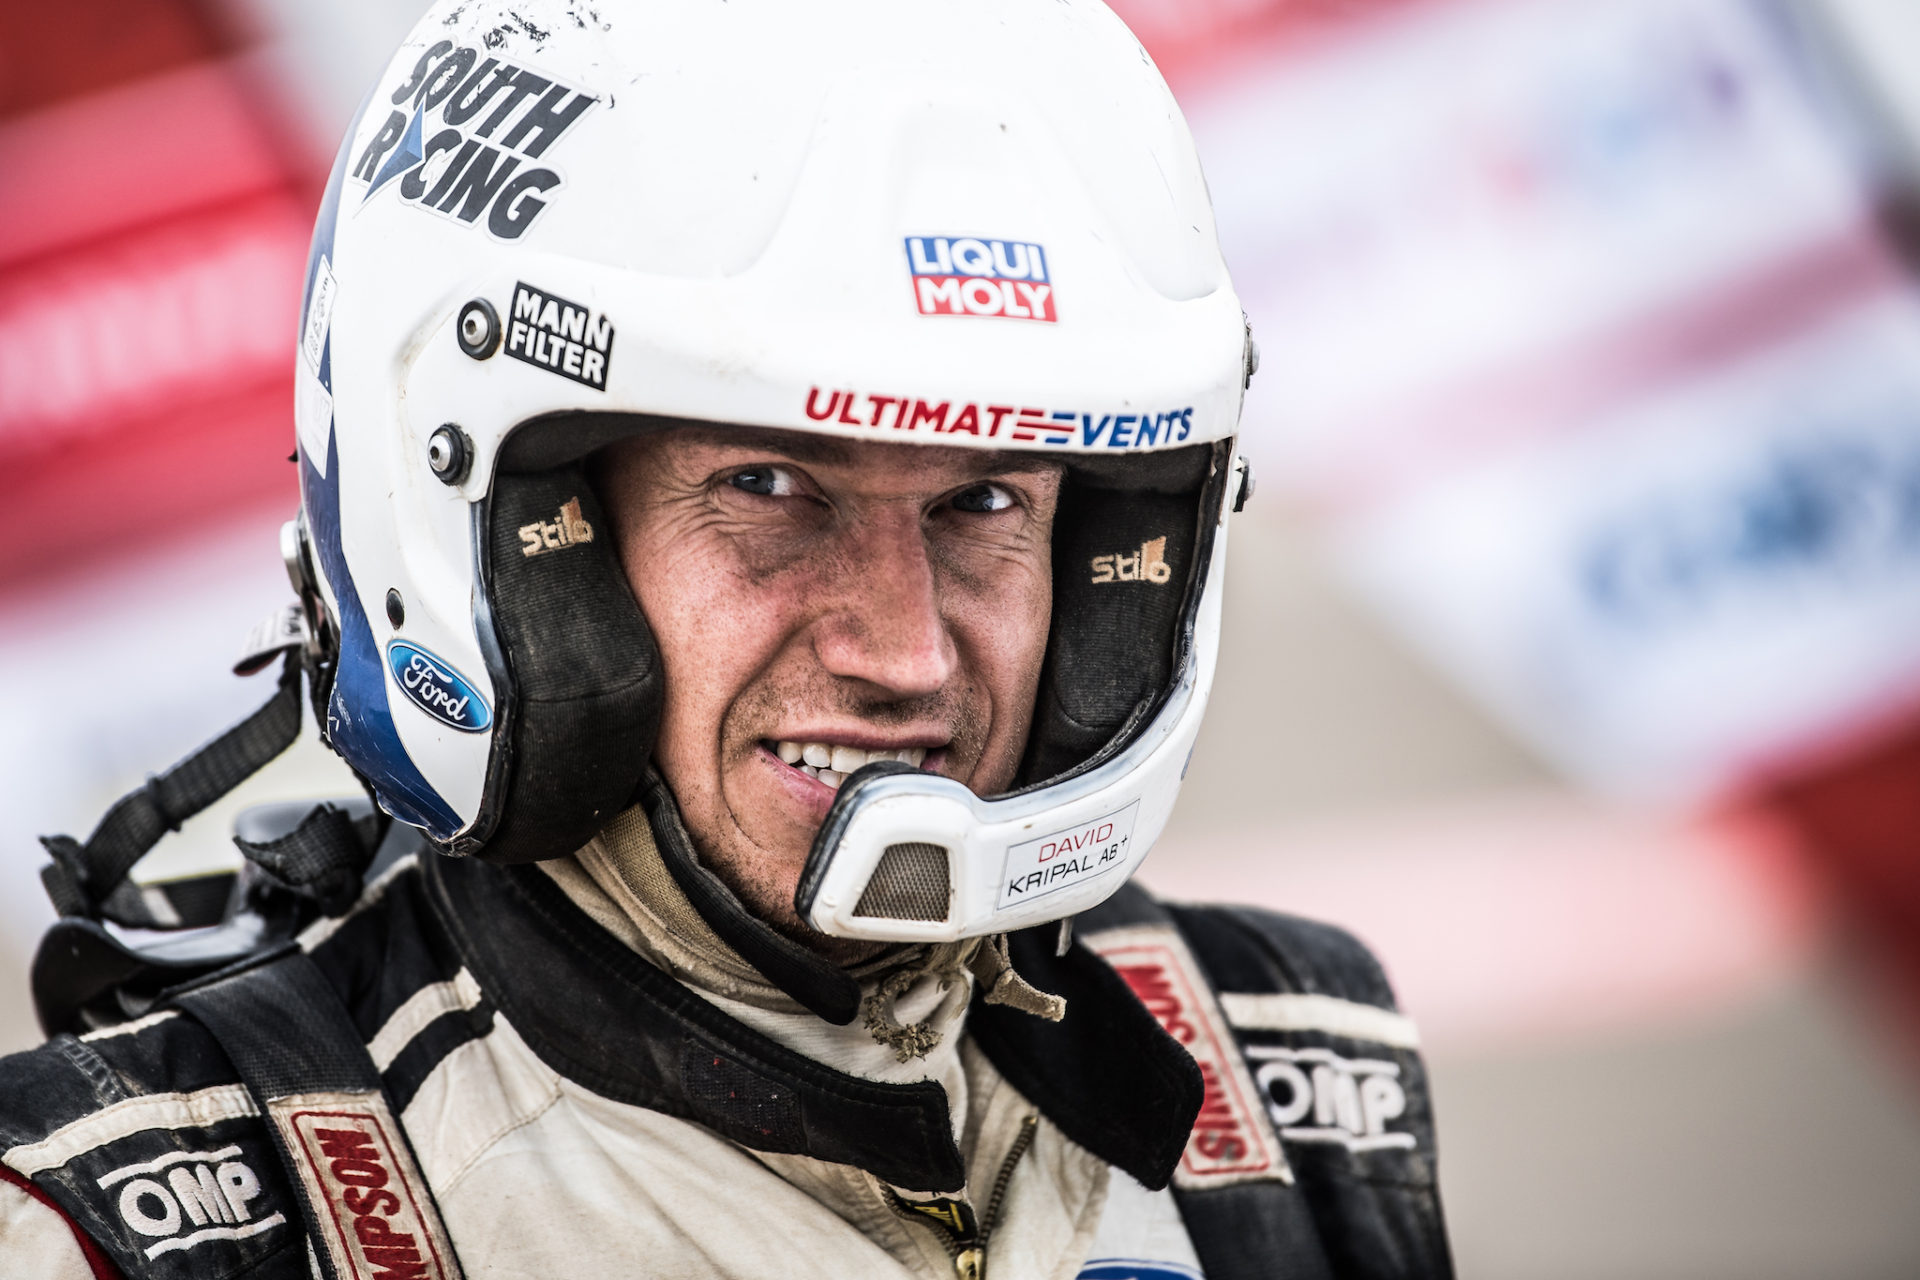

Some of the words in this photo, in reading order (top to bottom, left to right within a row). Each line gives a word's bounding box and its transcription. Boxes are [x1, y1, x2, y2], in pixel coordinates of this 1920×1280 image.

[391, 39, 600, 160] SOUTH
[908, 237, 1045, 281] LIQUI
[514, 288, 611, 352] MANN
[917, 277, 1052, 319] MOLY
[509, 320, 605, 384] FILTER
[403, 653, 470, 721] Ford
[1038, 823, 1113, 863] DAVID
[1007, 855, 1094, 897] KRIPAL
[1113, 964, 1247, 1161] SISON
[1256, 1062, 1406, 1135] OMP
[118, 1161, 262, 1237] OMP
